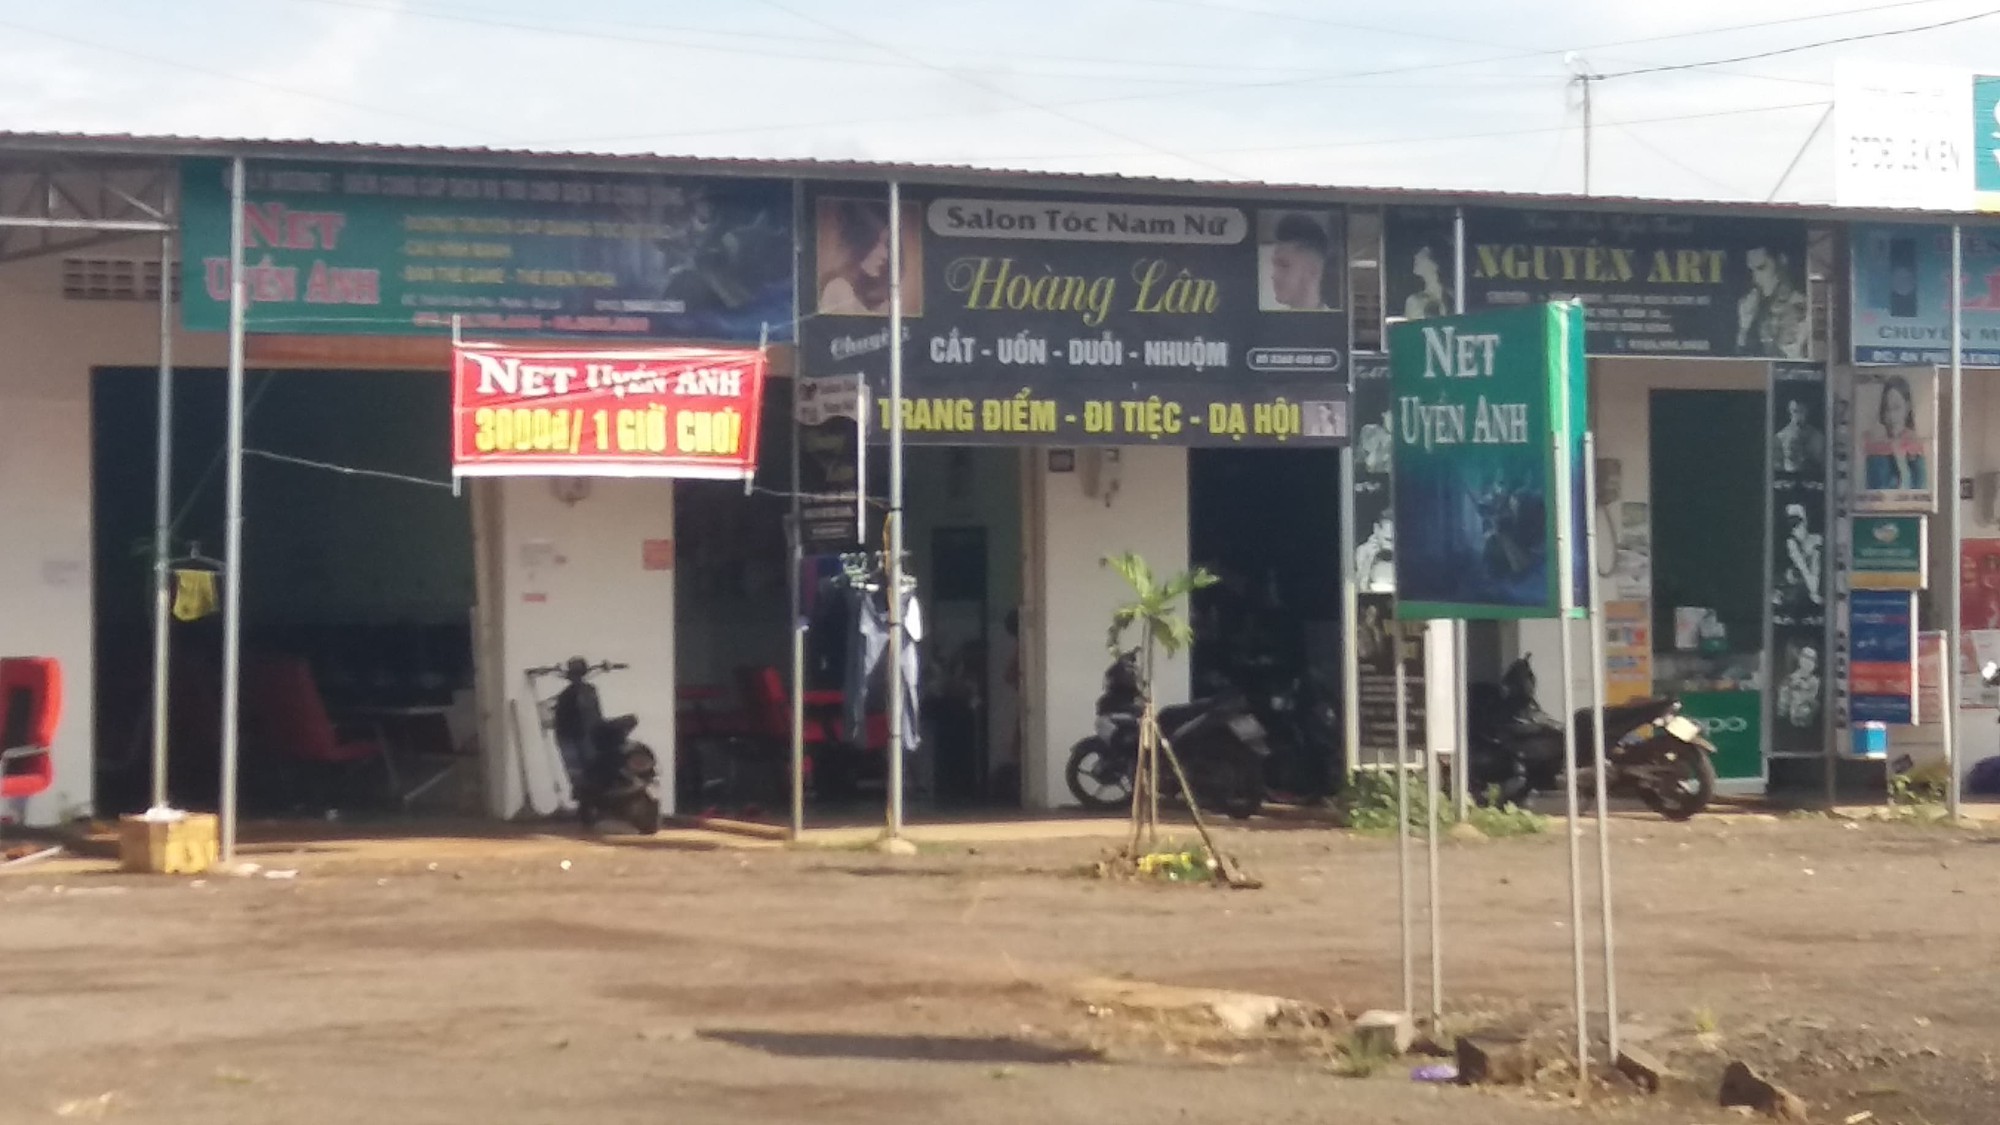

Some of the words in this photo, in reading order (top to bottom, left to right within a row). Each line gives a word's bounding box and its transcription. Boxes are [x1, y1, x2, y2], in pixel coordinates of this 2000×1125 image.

[243, 201, 346, 250] NET
[947, 206, 1037, 233] Salon
[1044, 209, 1098, 234] Tóc
[1107, 212, 1175, 236] Nam
[1184, 214, 1228, 236] Nữ
[304, 259, 380, 304] ANH
[1646, 251, 1727, 283] ART
[945, 257, 1117, 327] Hoàng
[1129, 258, 1220, 314] Lân
[930, 328, 976, 364] CẮT
[998, 330, 1046, 365] UỐN
[1144, 335, 1229, 372] NHUỘM
[1422, 325, 1501, 378] NET
[473, 355, 577, 395] NET
[594, 408, 608, 450] 1
[878, 398, 975, 431] TRANG
[982, 386, 1056, 432] ĐIỂM
[1084, 402, 1113, 433] ĐI
[1121, 395, 1182, 440] TIỆC
[1208, 403, 1247, 441] DẠ
[1254, 397, 1299, 441] HỘI
[1399, 391, 1466, 453] UYÊN
[1472, 395, 1528, 443] ANH
